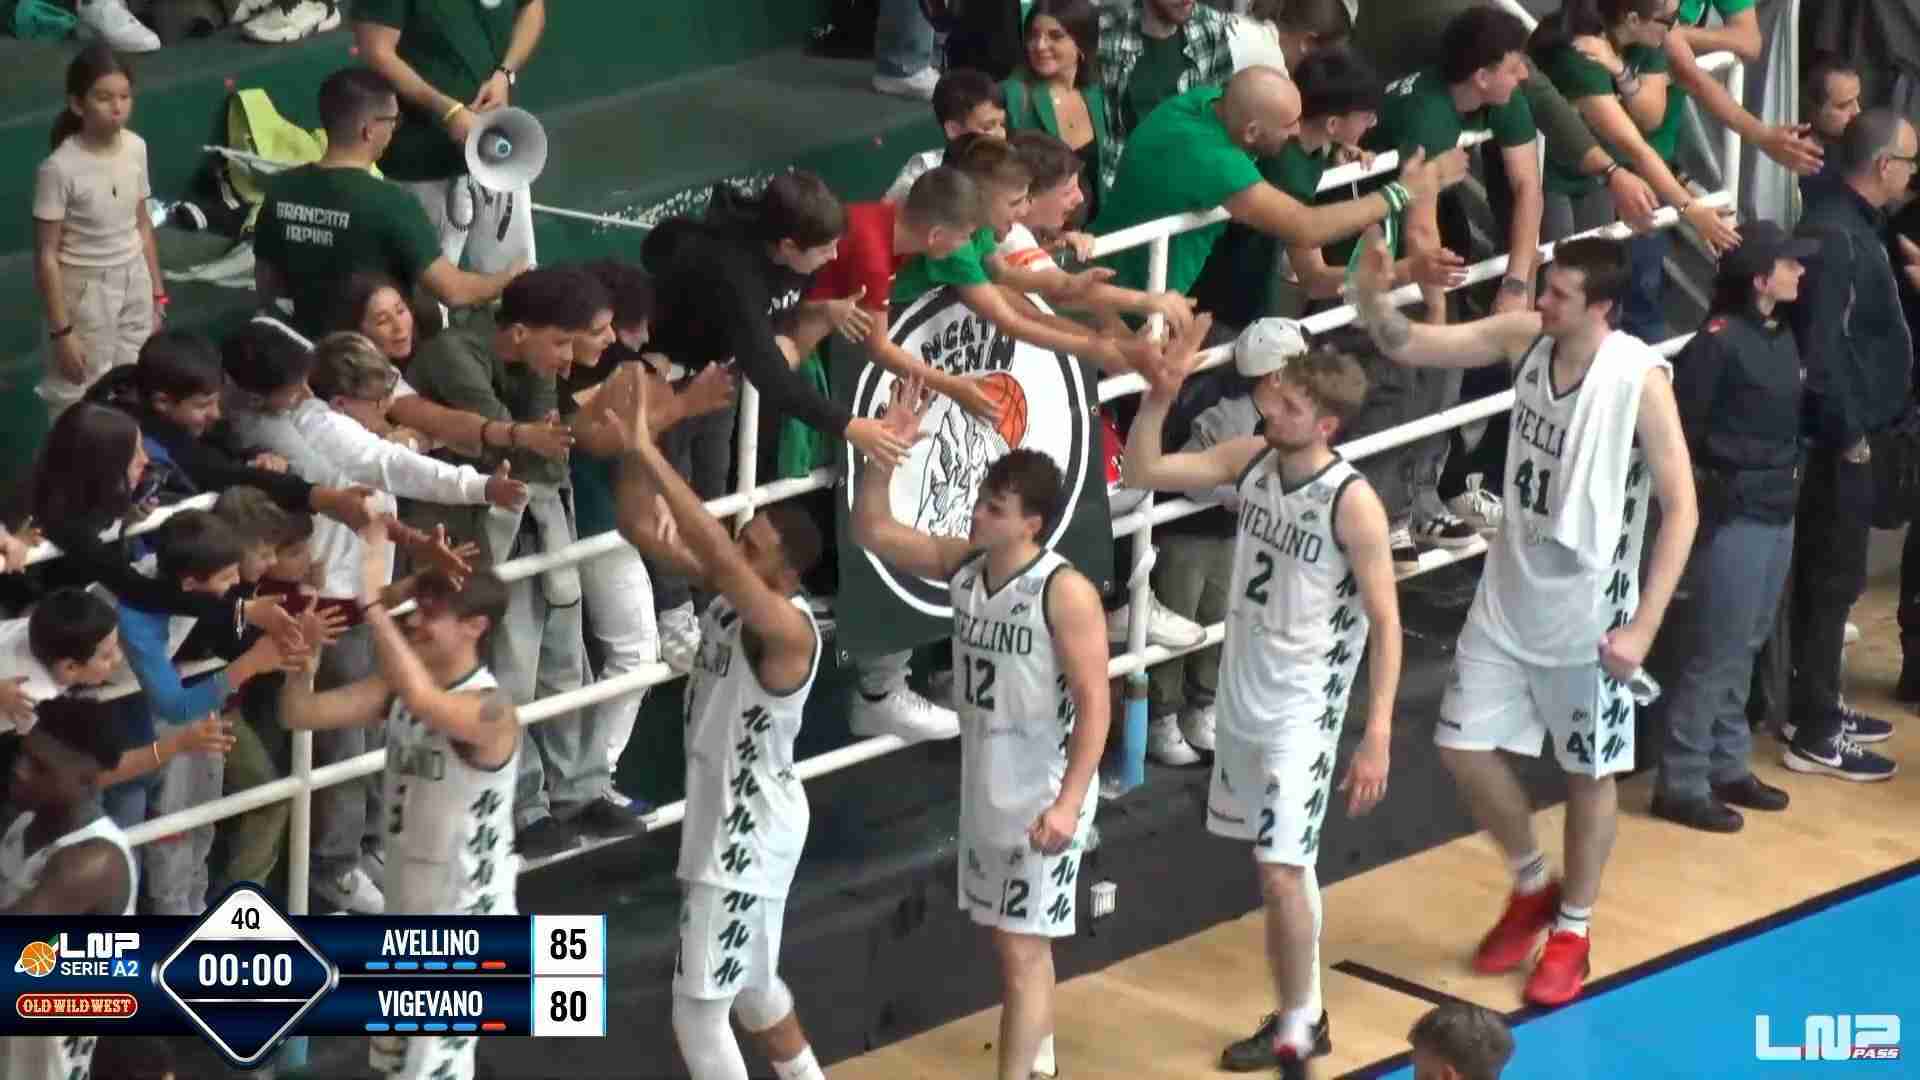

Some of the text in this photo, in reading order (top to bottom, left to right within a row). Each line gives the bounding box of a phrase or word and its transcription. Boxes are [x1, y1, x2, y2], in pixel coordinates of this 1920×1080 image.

[1513, 457, 1552, 516] 41
[1244, 550, 1275, 606] 2
[963, 653, 996, 713] 12
[1256, 807, 1276, 848] 2
[999, 878, 1030, 920] 12
